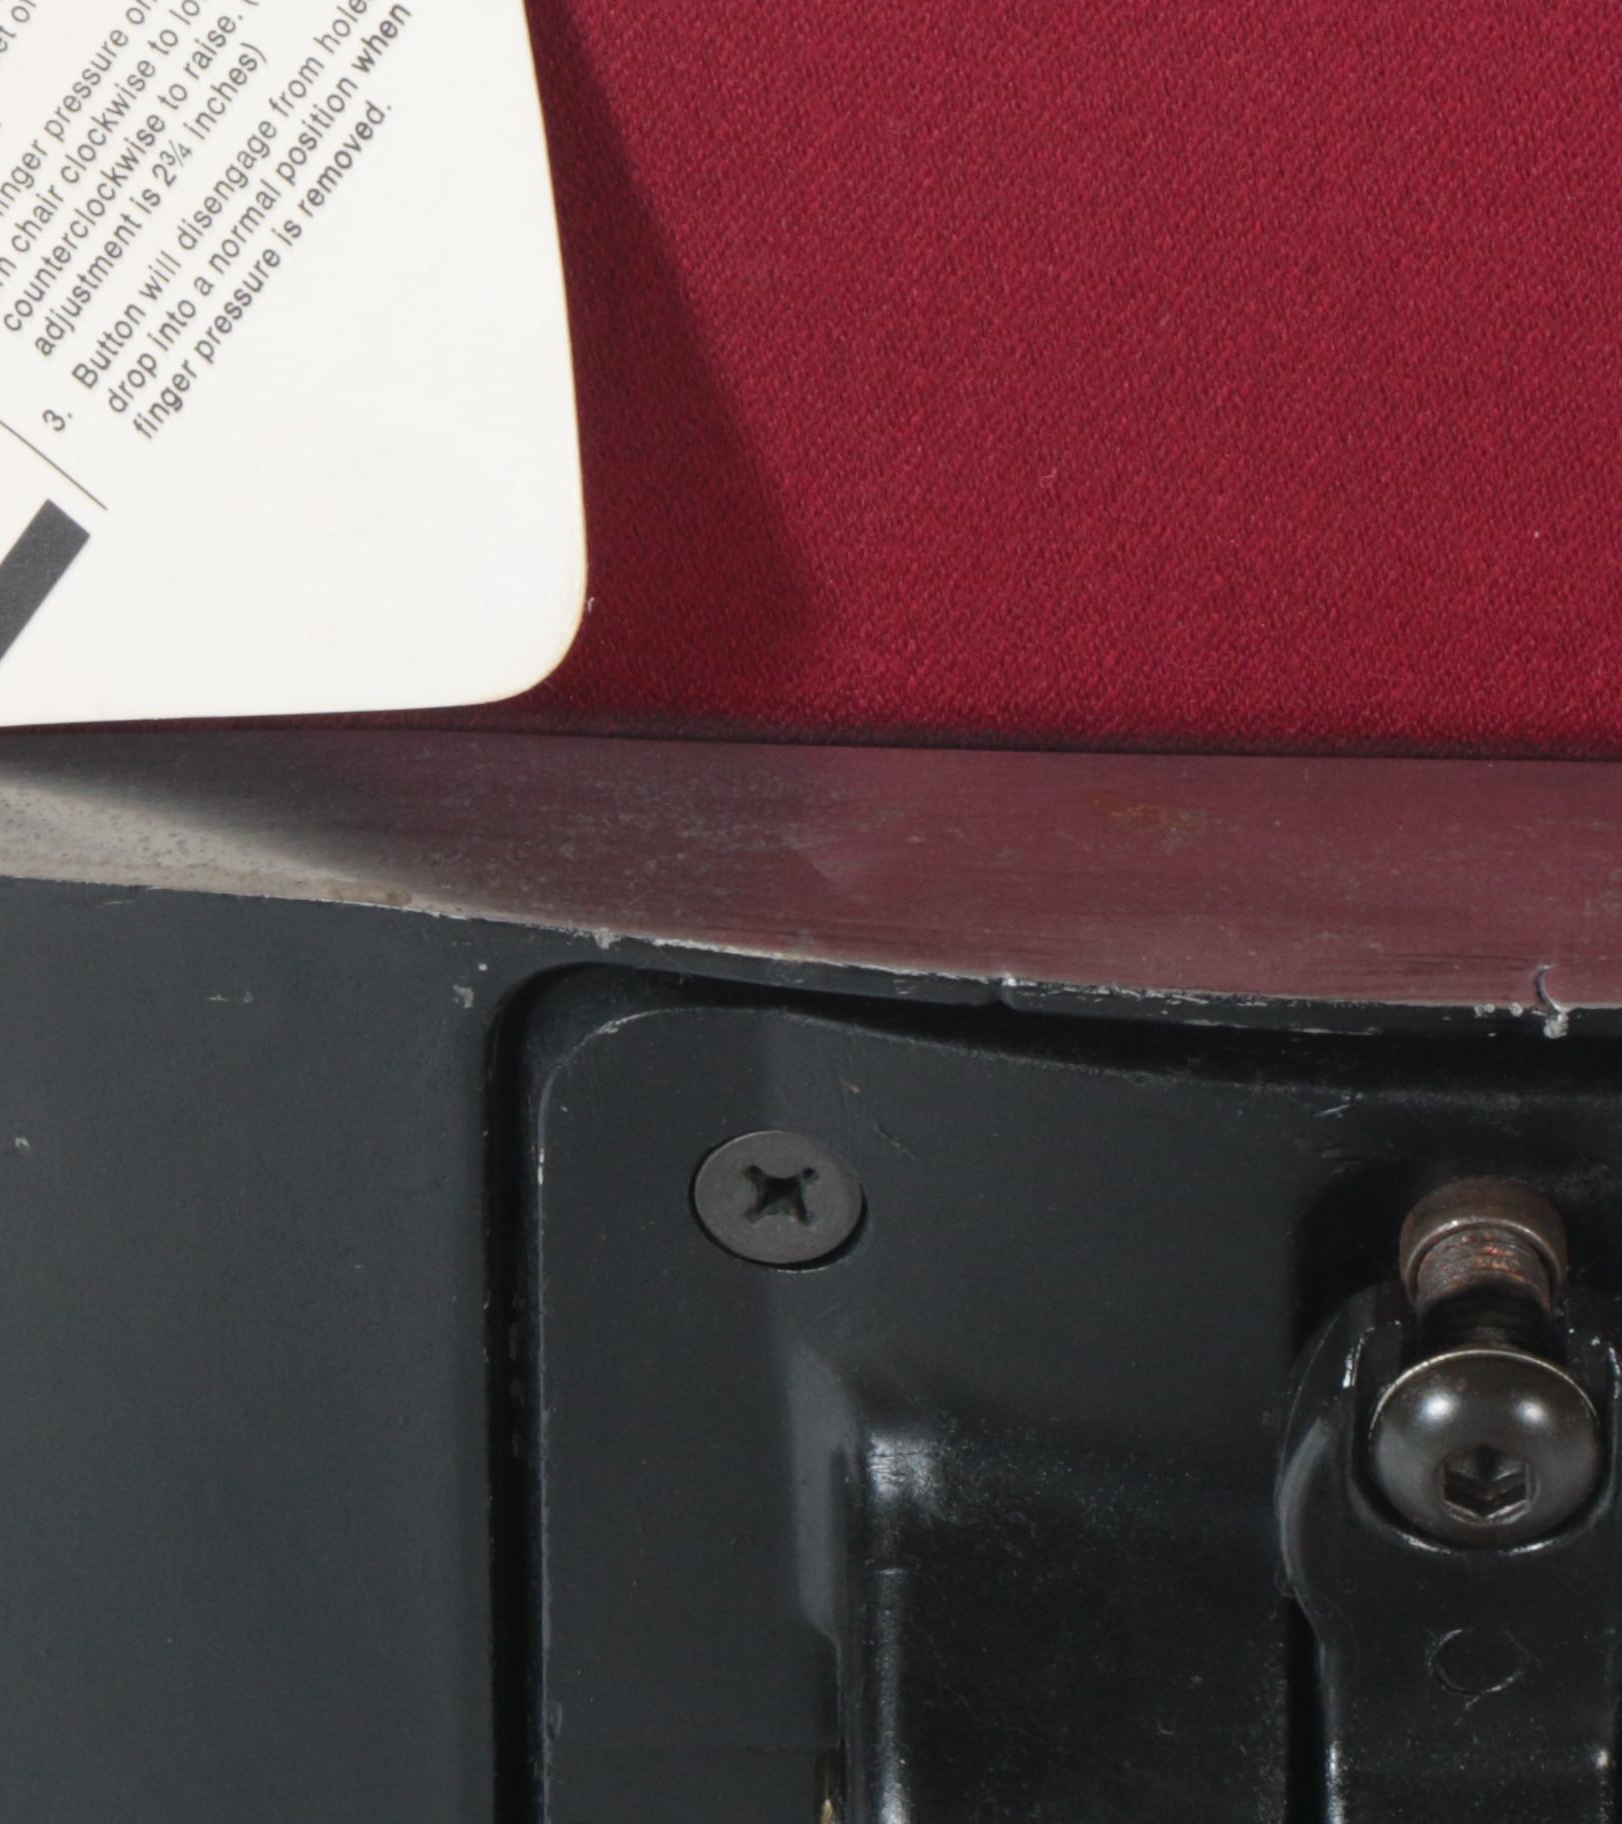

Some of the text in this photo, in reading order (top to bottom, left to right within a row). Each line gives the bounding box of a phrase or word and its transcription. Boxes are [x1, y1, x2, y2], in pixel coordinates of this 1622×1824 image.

[2, 113, 166, 332] counterclockwise
[156, 82, 188, 110] to
[182, 14, 243, 80] raise.
[10, 183, 64, 253] chair
[59, 59, 156, 184] clockwise
[147, 28, 179, 56] to
[33, 212, 142, 357] adjustment
[128, 187, 161, 215] is
[182, 41, 267, 140] inches)
[41, 408, 72, 432] 3.
[70, 303, 146, 390] Button
[137, 249, 181, 301] will
[176, 119, 277, 251] disengage
[267, 56, 324, 117] from
[42, 28, 129, 143] pressure
[107, 3, 411, 413] drop into a normal position when
[132, 99, 391, 439] finger pressure is removed.
